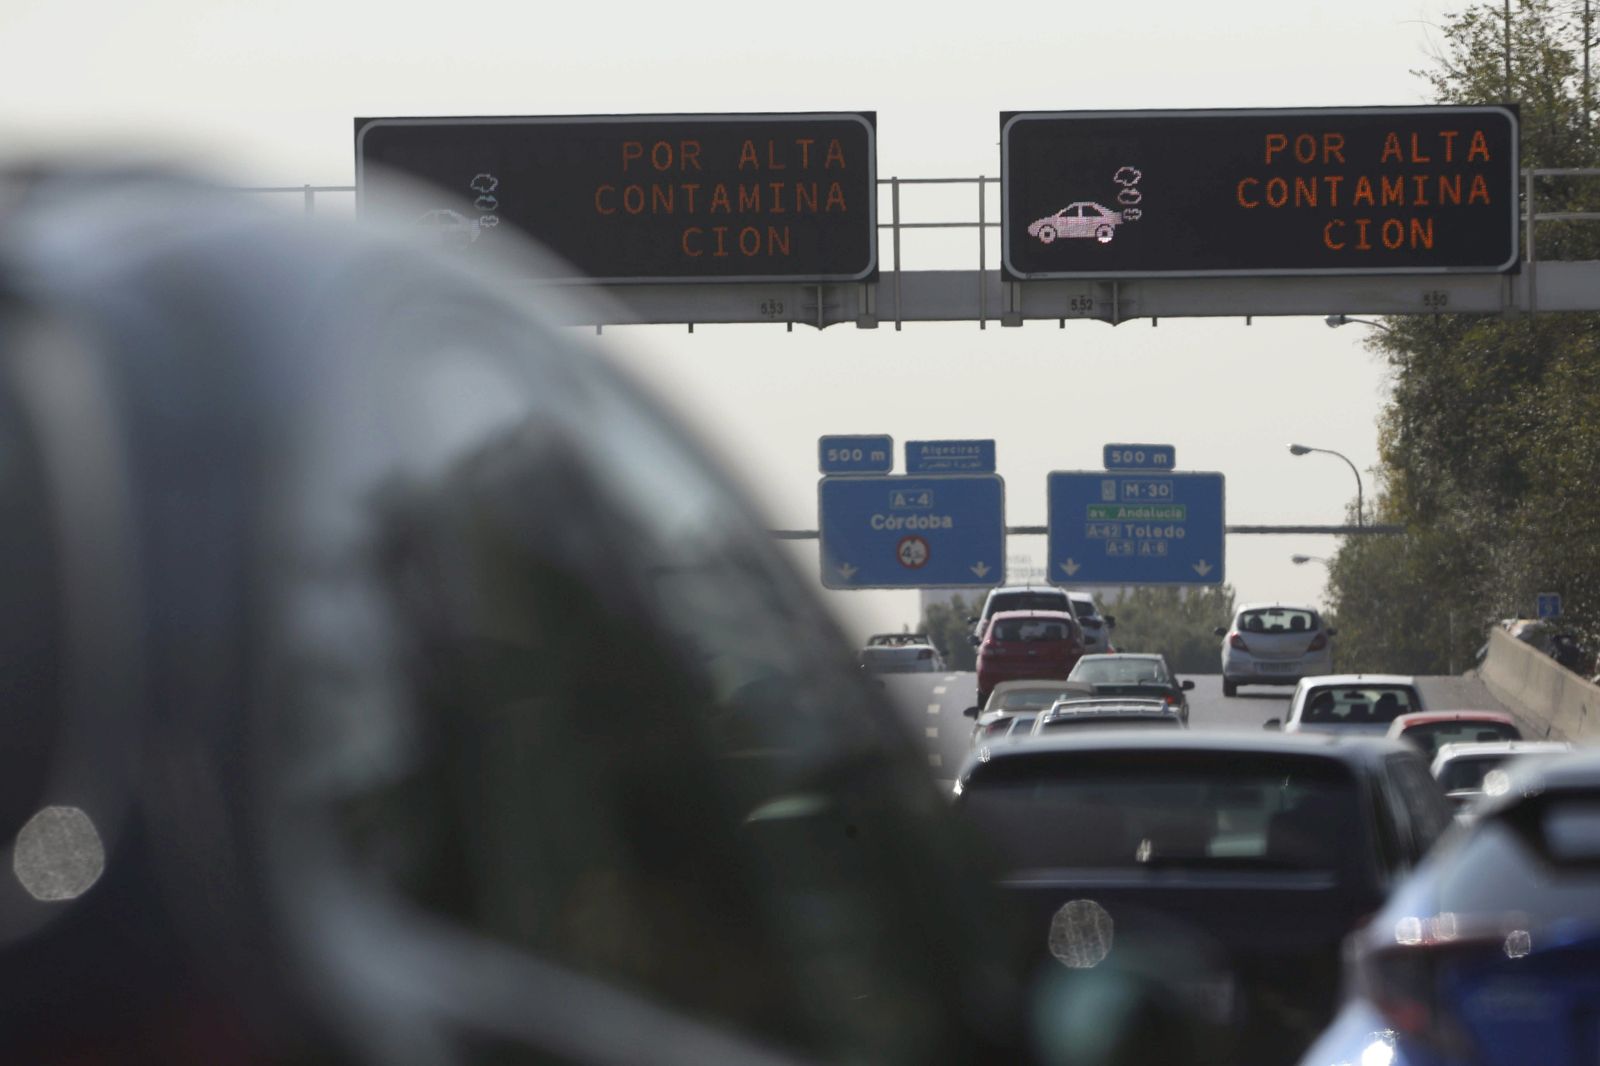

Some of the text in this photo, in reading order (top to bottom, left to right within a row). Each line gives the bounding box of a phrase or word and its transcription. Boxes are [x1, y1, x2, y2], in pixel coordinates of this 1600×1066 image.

[623, 138, 846, 171] POR ALTA
[1265, 130, 1490, 164] POR ALTA
[595, 182, 847, 214] CONTAMINA
[1237, 175, 1490, 208] CONTAMINA
[682, 226, 790, 256] CION
[1323, 218, 1434, 250] CION
[827, 448, 886, 462] 500 m
[1111, 450, 1168, 464] 500 m
[894, 492, 929, 506] A-4
[1126, 484, 1170, 498] M-30
[870, 514, 953, 530] Córdoba
[1125, 523, 1186, 538] Toledo
